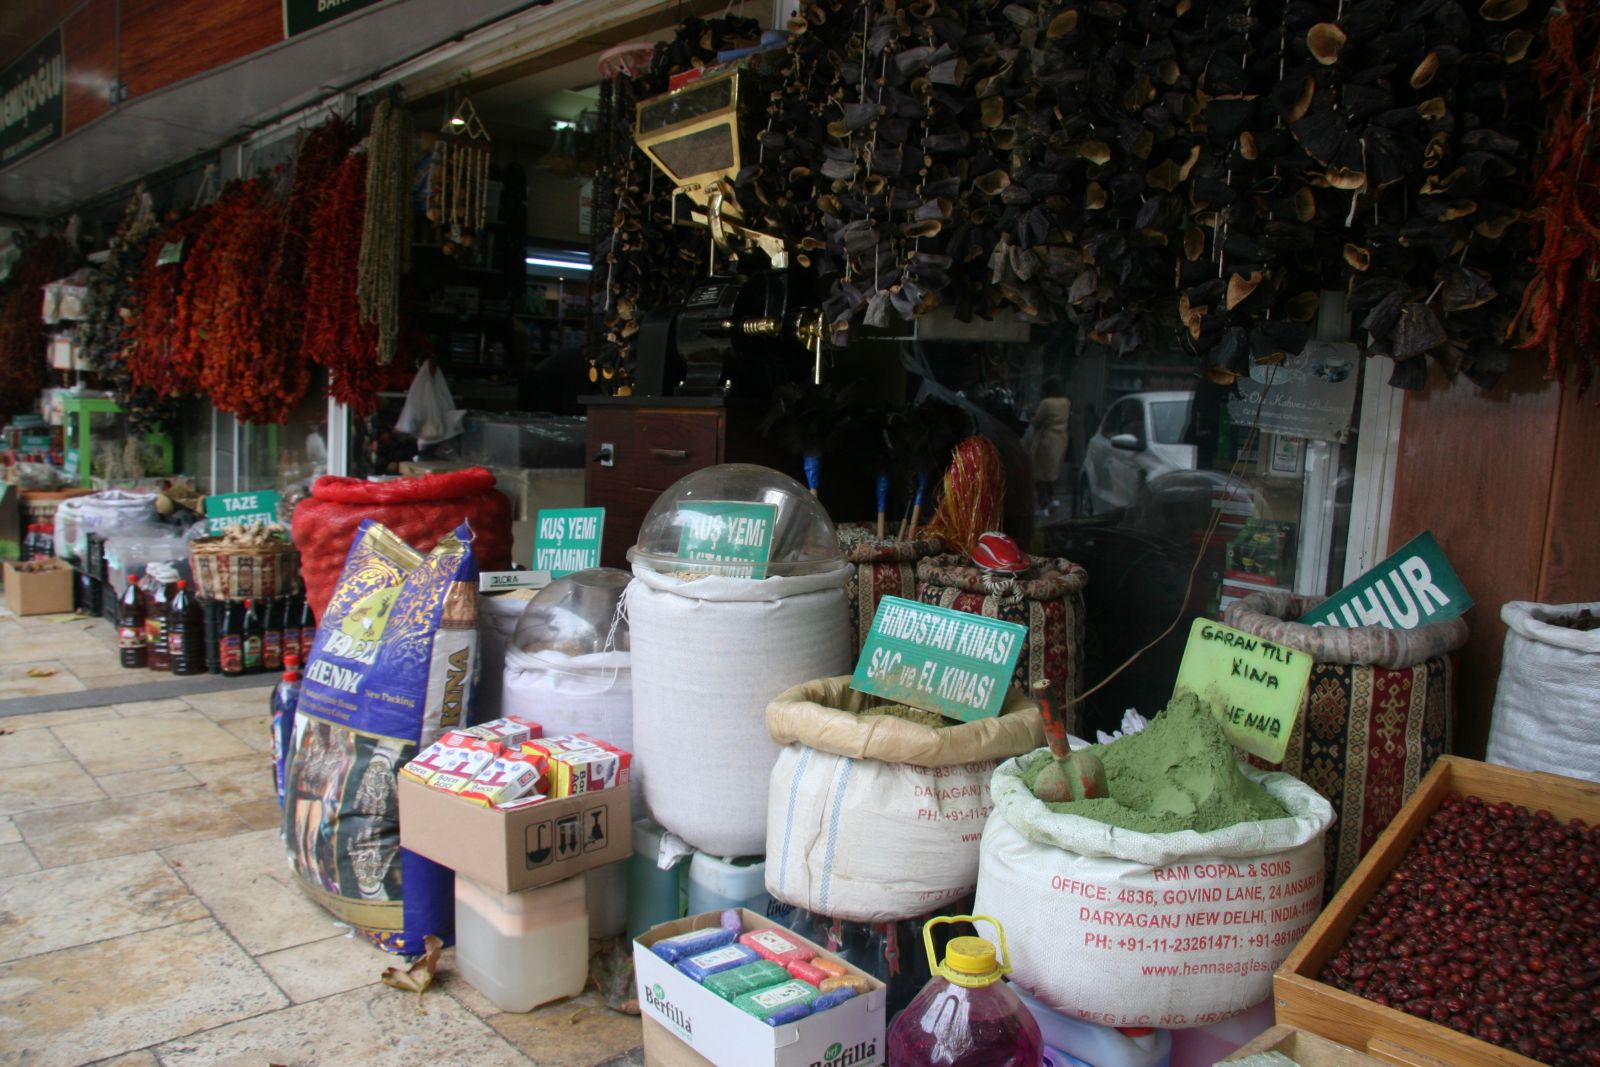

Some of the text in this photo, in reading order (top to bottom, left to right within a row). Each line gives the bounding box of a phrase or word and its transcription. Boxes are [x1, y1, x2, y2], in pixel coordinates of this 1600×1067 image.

[222, 495, 258, 512] TAZE
[540, 516, 565, 546] KUŞ
[956, 624, 1015, 665] KINASI
[306, 658, 364, 695] HENNA
[899, 665, 916, 688] ve
[917, 660, 938, 694] EL
[937, 666, 995, 711] KINASI
[1231, 656, 1279, 689] KINA
[381, 692, 416, 710] Packing
[440, 646, 470, 739] KINA
[1223, 703, 1281, 739] HENNA
[1153, 860, 1292, 881] RAM GOPAL & SONS
[1051, 875, 1112, 902] OFFICE:
[1116, 889, 1158, 907] 4836,
[1163, 887, 1222, 905] GOVIND
[1226, 886, 1265, 903] LANE,
[1269, 886, 1281, 900] 24
[1080, 906, 1181, 928] DARYAGANJ
[1186, 911, 1220, 927] NEW
[1223, 909, 1267, 927] DELHI,
[1084, 932, 1112, 950] PH:
[1117, 936, 1244, 953] +91-11-23261471:
[1141, 957, 1287, 977] www.hennaeagles.co
[644, 984, 693, 1035] Berfilla
